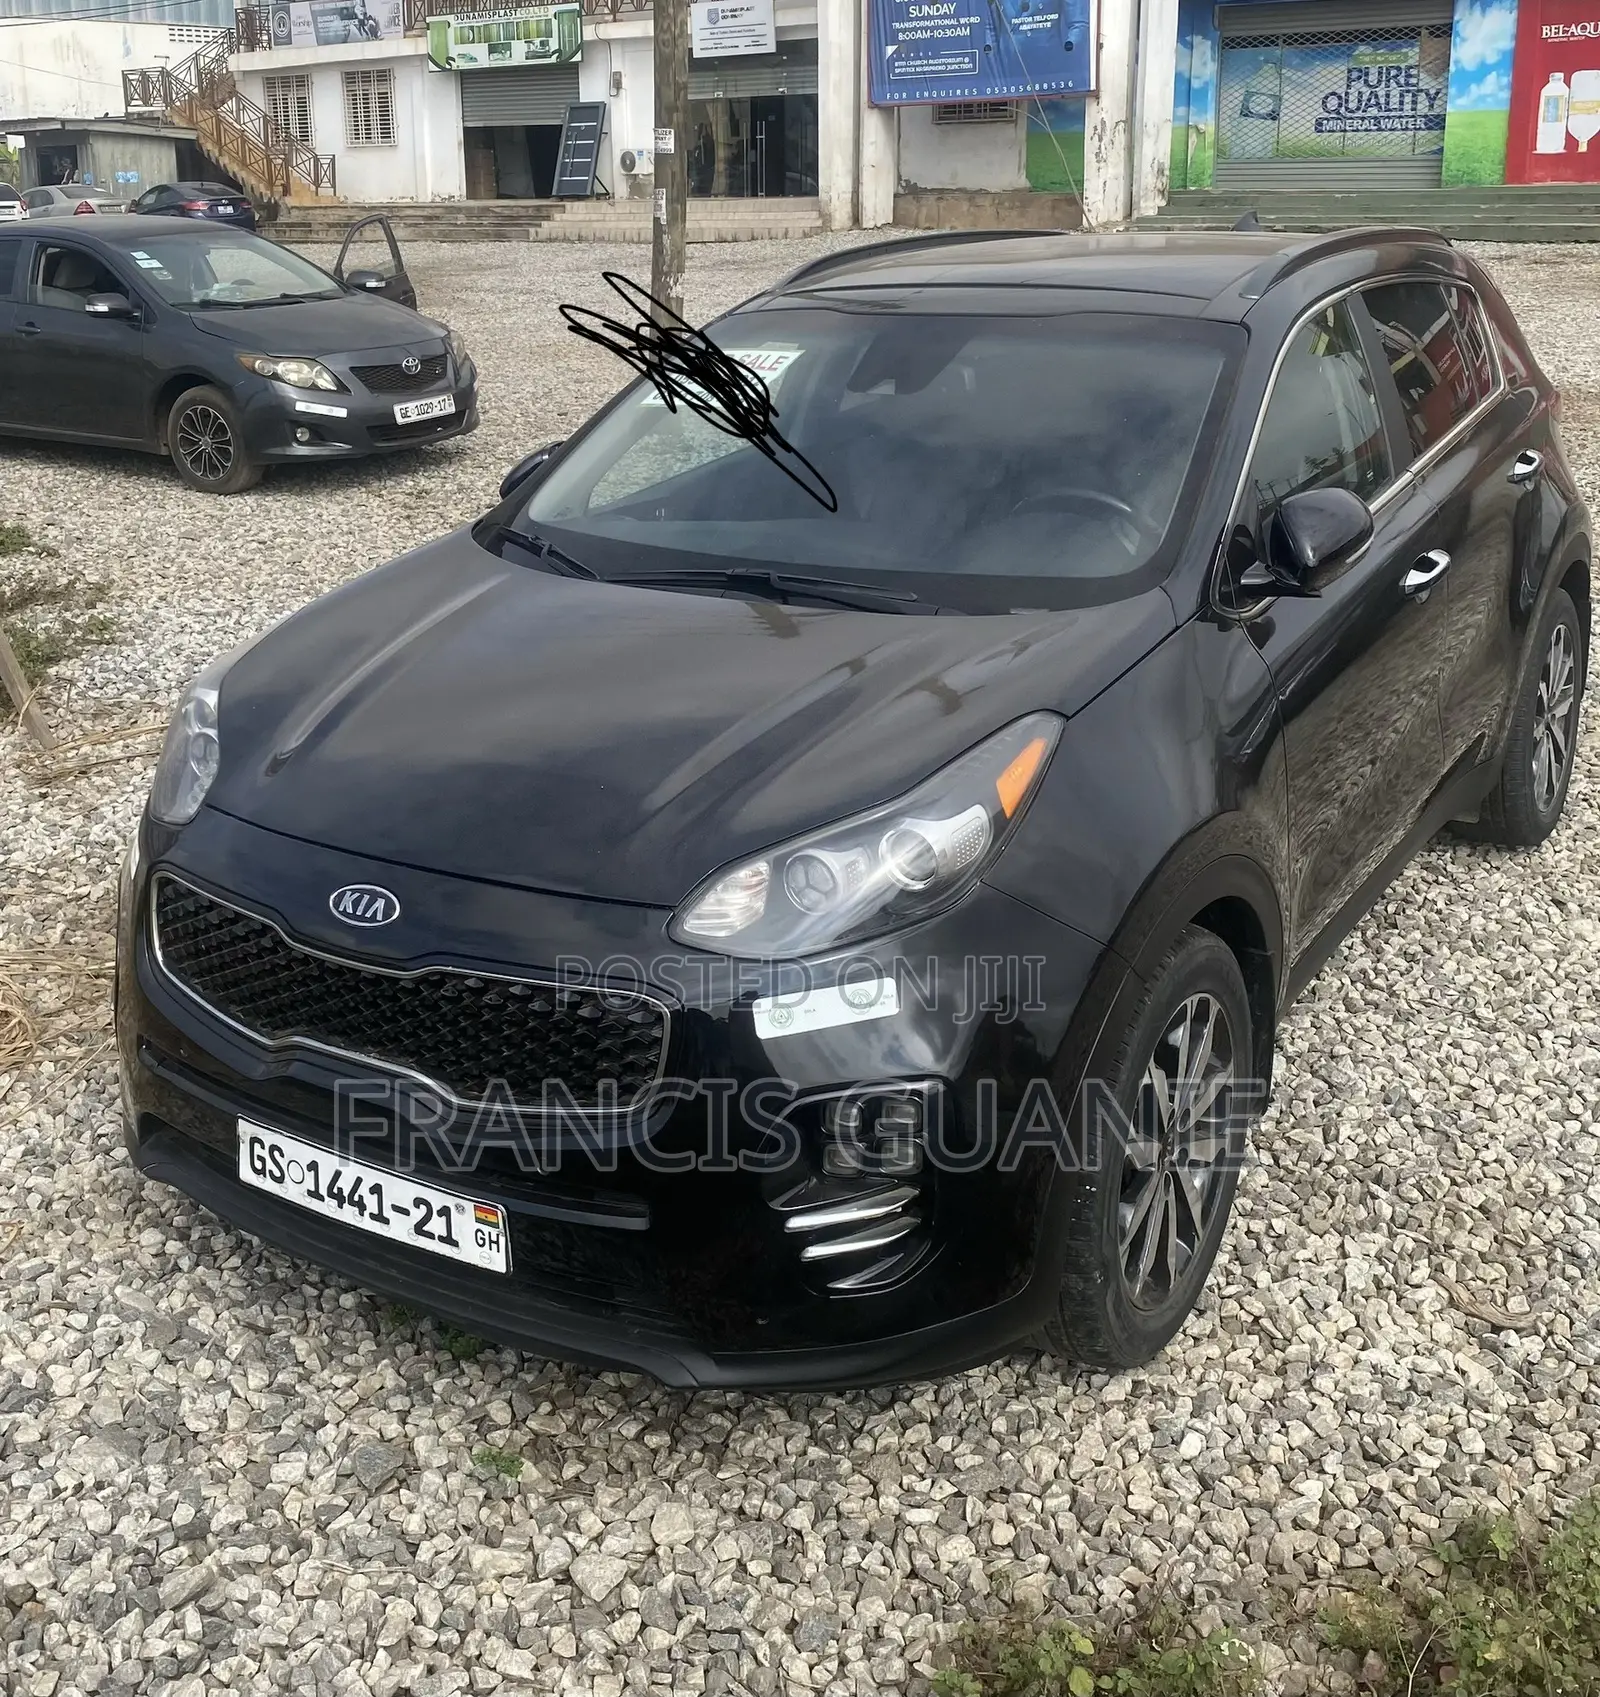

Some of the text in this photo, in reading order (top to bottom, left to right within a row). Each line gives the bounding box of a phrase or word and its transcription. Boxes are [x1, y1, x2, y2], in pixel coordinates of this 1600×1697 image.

[453, 9, 518, 22] DUNAMISPLAST
[908, 2, 957, 18] SUNDAY
[1011, 13, 1059, 24] PASTOR TELFORD
[892, 16, 980, 29] TRANSFORMATIONAL WORD
[898, 26, 970, 41] 8:00AM-10:30AM
[1347, 65, 1419, 90] PURE
[886, 92, 907, 100] FOR
[916, 88, 978, 99] ENQUIRES
[1322, 88, 1441, 117] QUALITY
[1321, 118, 1426, 131] MINERAL WATER
[739, 354, 790, 372] SALE
[399, 397, 447, 419] GE 1029-17
[338, 890, 386, 921] KIA
[249, 1136, 460, 1248] GS 1441-21
[474, 1228, 500, 1253] GH
